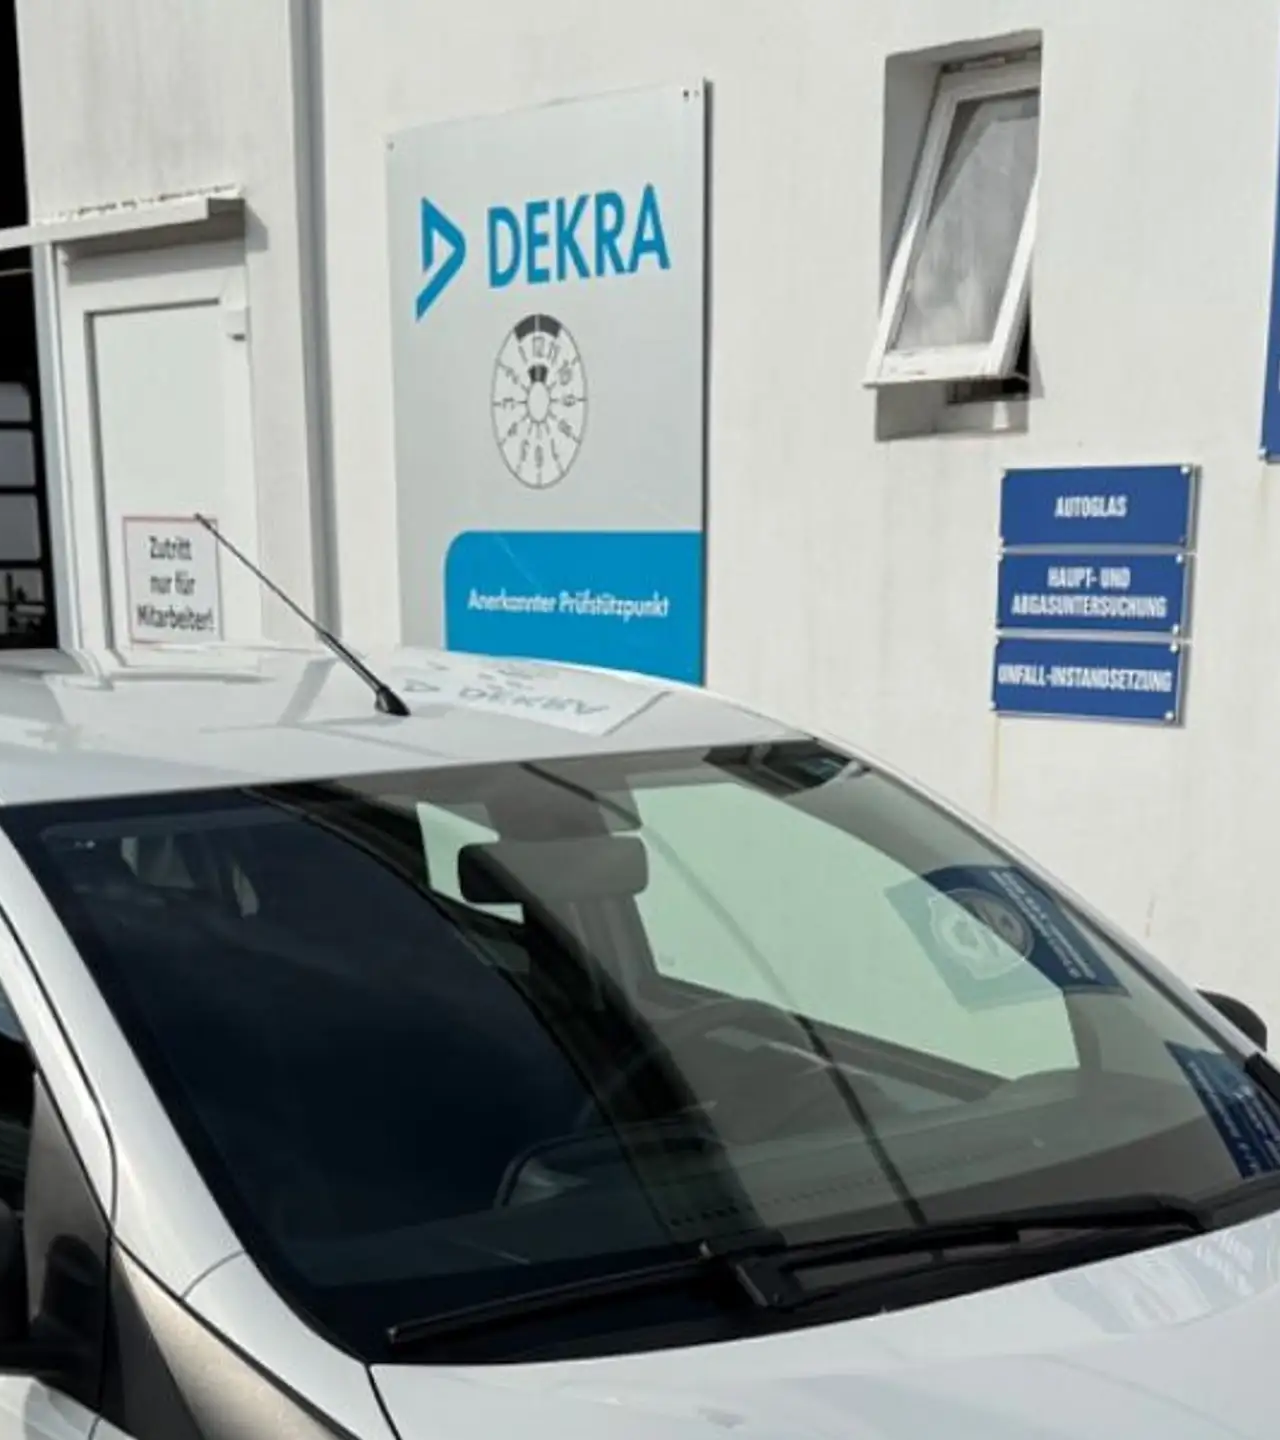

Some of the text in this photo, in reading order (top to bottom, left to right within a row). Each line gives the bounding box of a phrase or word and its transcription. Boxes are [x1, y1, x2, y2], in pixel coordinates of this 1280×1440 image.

[487, 184, 671, 289] DEKRA
[1054, 494, 1127, 518] AUTOGLAS
[149, 535, 193, 560] Zutritt
[1047, 566, 1131, 590] HAUPT- UND
[468, 588, 671, 623] Anerkannter Prüfstützpunkt
[997, 663, 1173, 692] UNFALL-INSTANDSETZUNG
